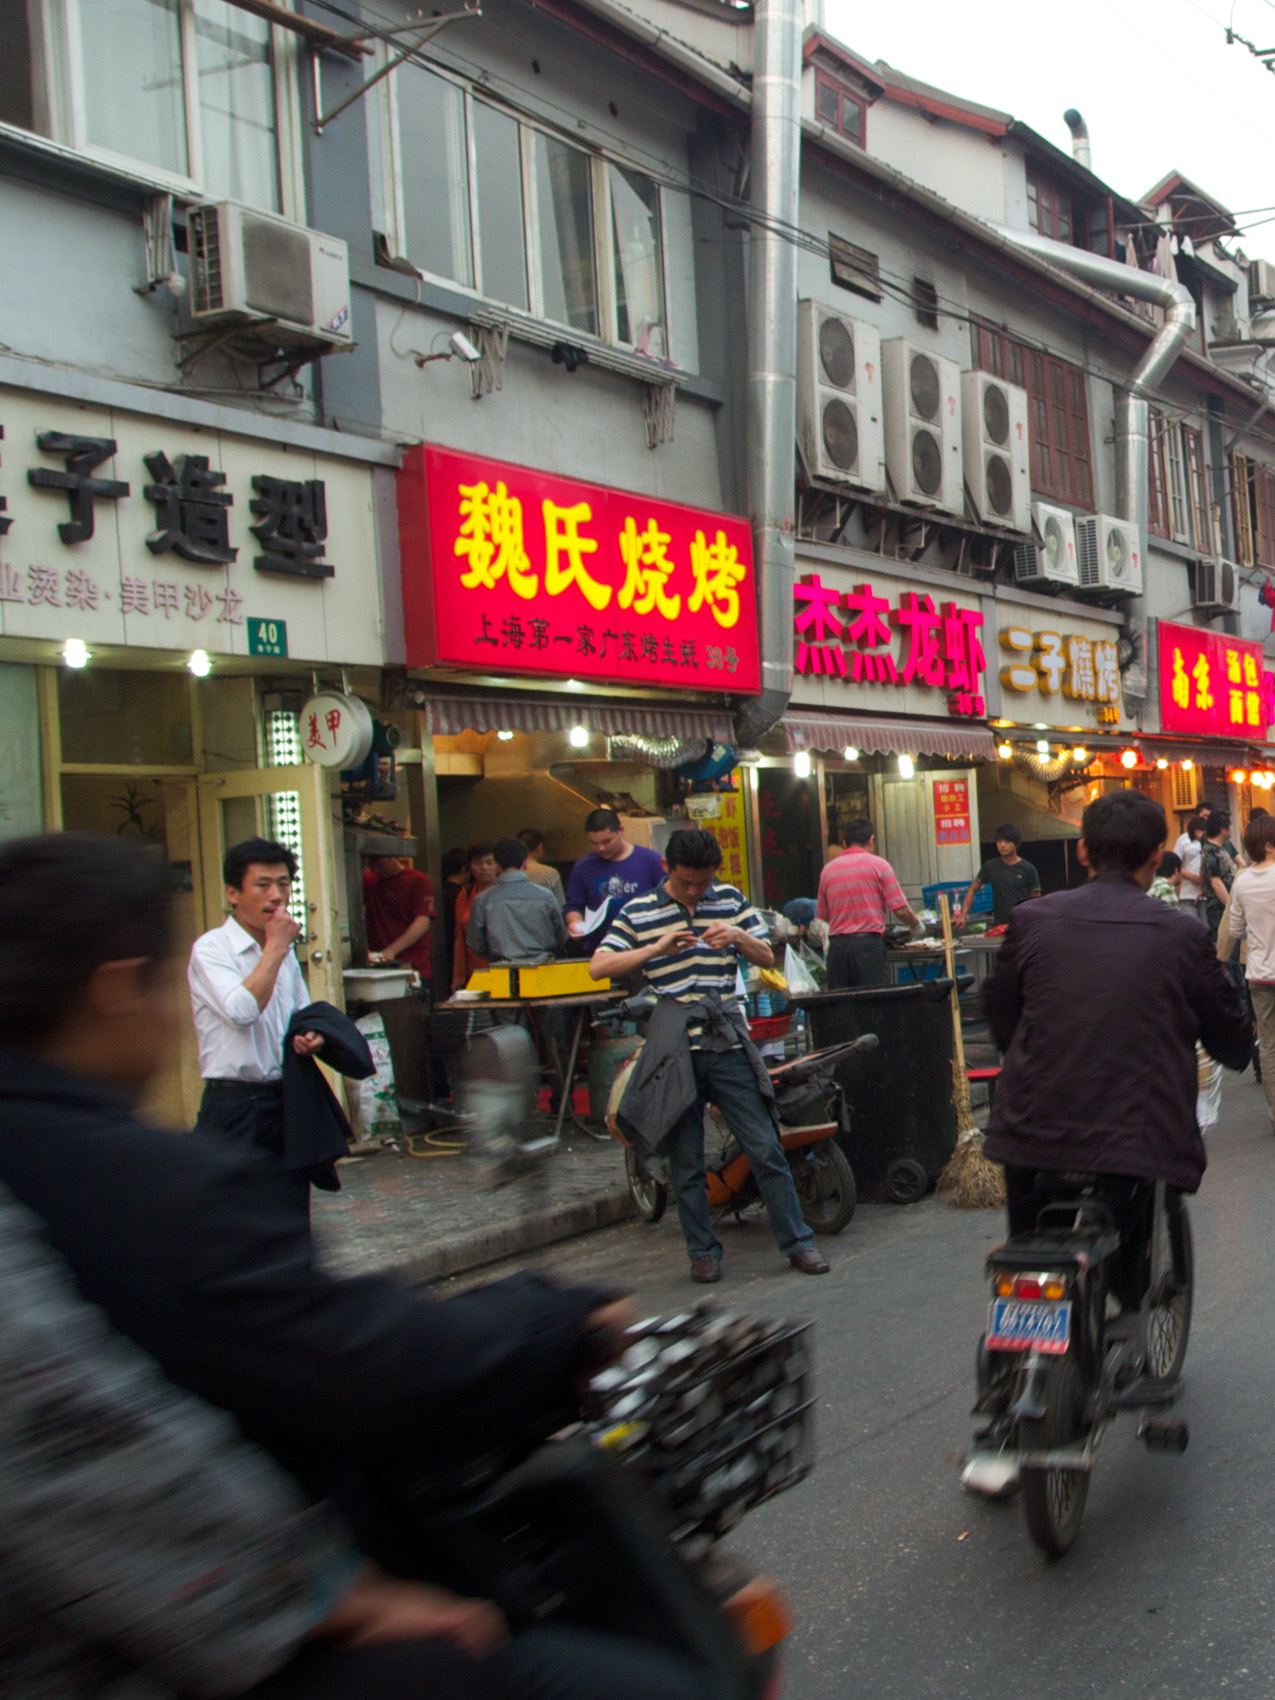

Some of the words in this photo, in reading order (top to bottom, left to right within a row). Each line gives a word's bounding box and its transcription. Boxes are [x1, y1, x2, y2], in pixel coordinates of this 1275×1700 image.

[0, 425, 335, 578] 子造型
[455, 481, 746, 628] 魏氏烧烤
[259, 622, 278, 644] 40
[476, 613, 699, 669] 上海第一家广东烤生蚝
[705, 645, 739, 673] 38号
[793, 573, 986, 694] 杰杰龙虾
[308, 709, 342, 750] 美甲
